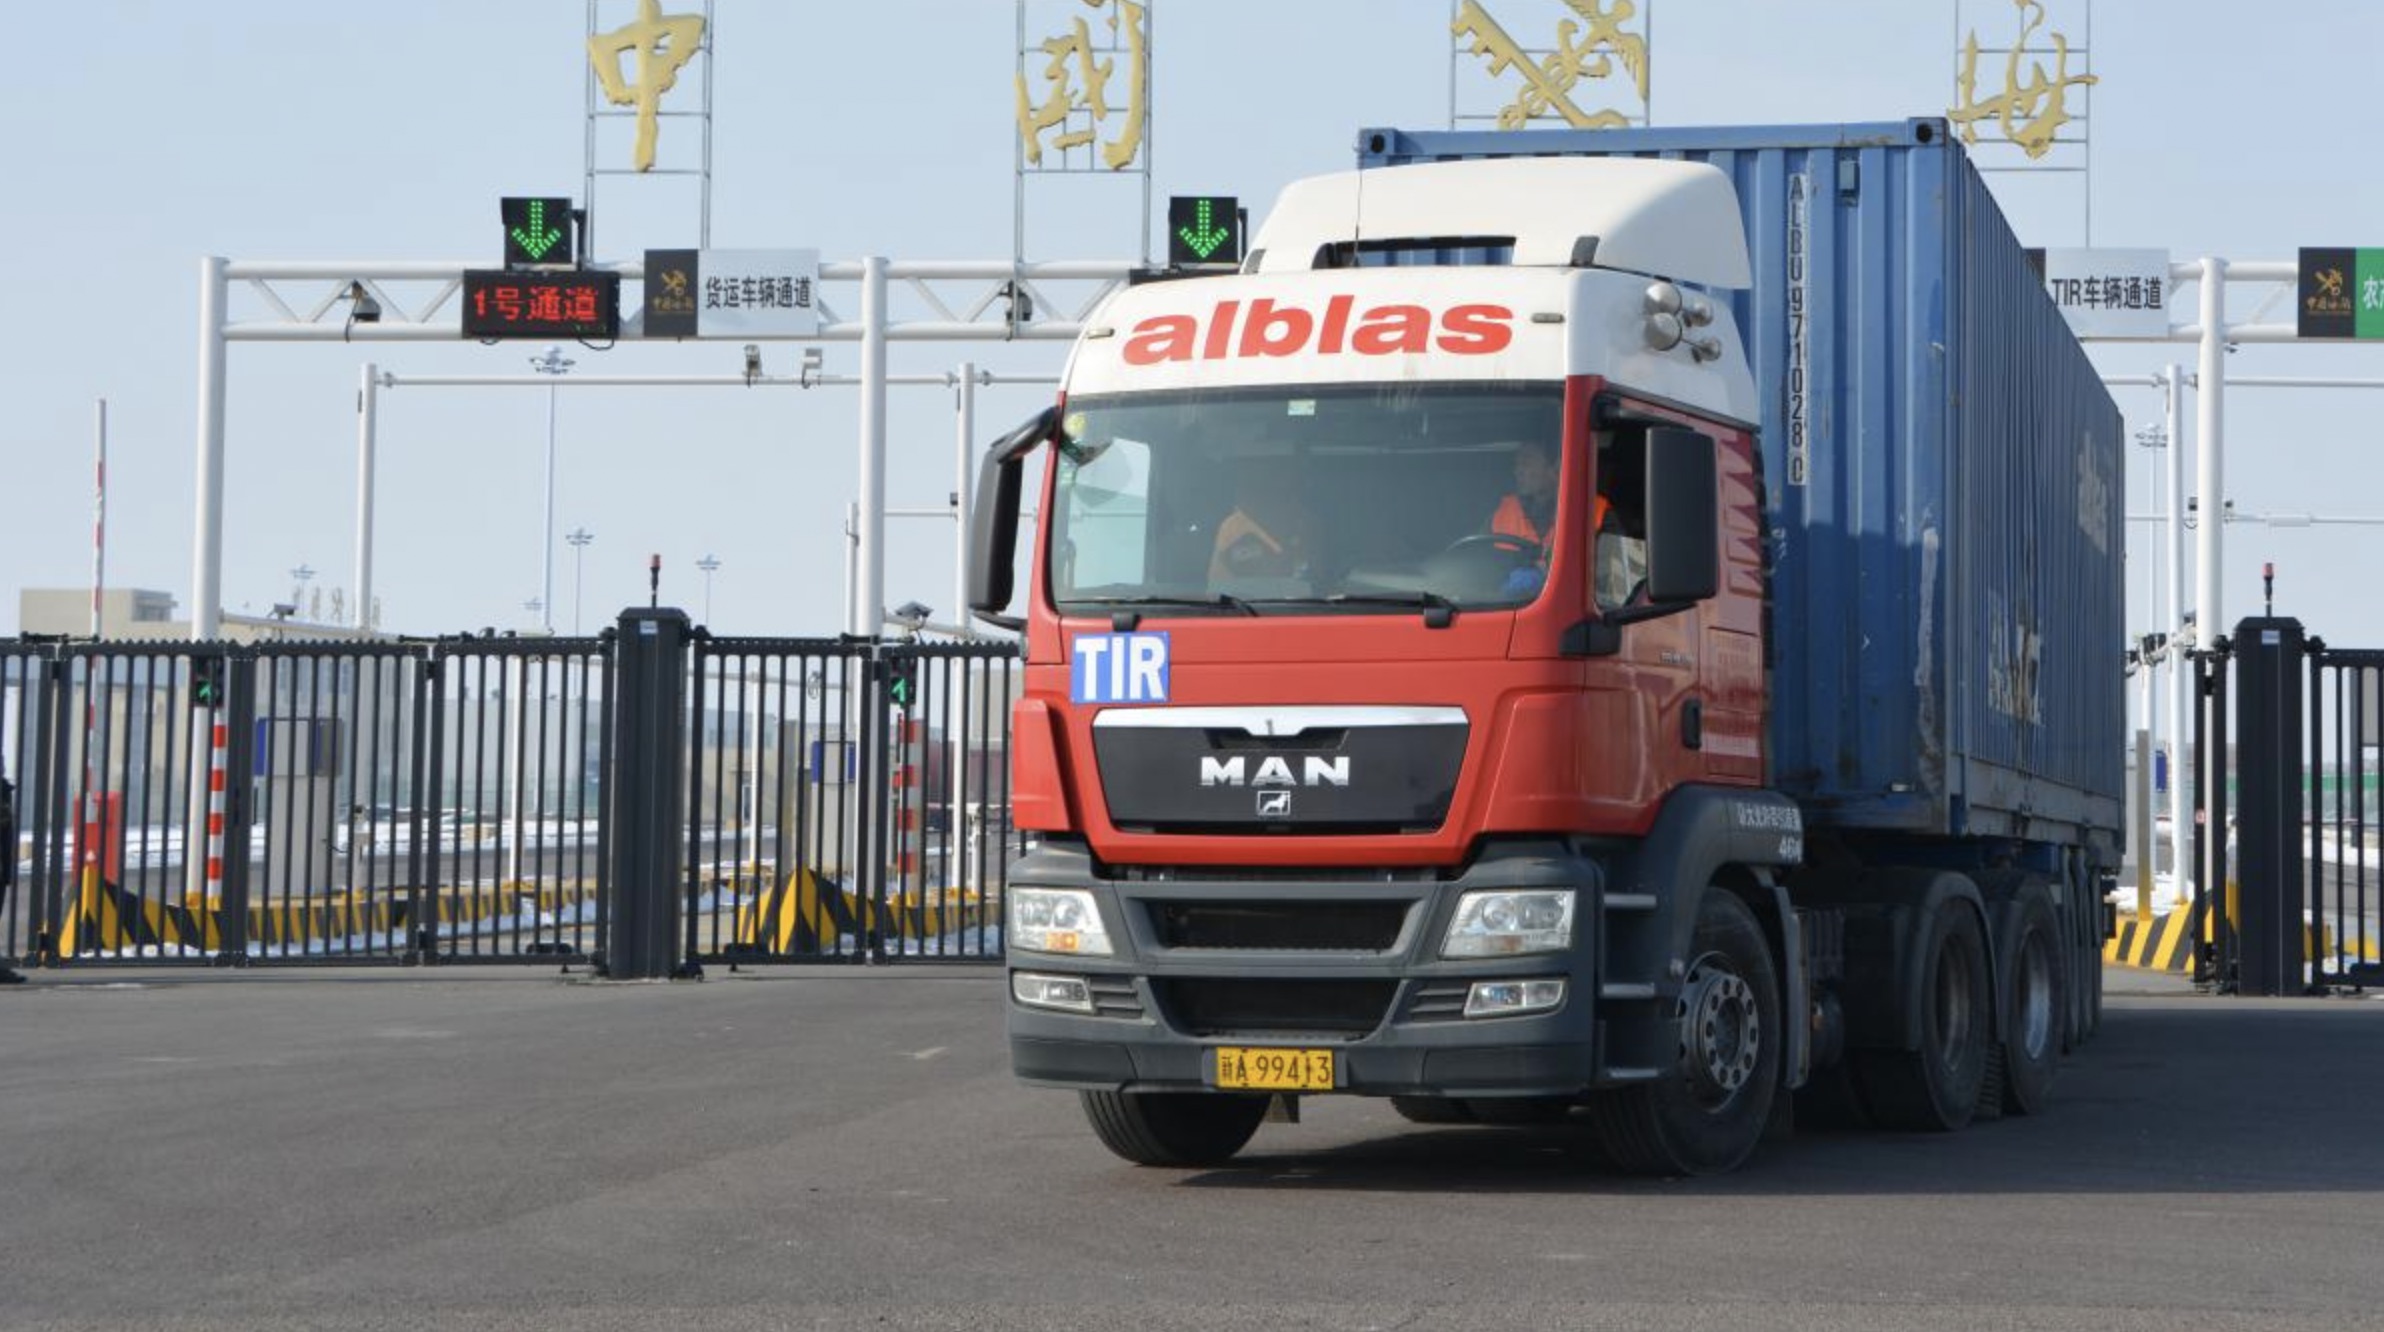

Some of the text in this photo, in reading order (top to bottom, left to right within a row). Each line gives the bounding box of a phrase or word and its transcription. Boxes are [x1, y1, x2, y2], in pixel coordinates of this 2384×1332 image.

[474, 285, 599, 321] 1号通道
[705, 275, 812, 309] 货运车辆通道
[2051, 275, 2163, 310] TIR车辆通道
[2363, 274, 2384, 311] 农
[1122, 295, 1513, 365] alblas
[1790, 286, 1803, 447] 971028
[1076, 637, 1165, 700] TIR
[1201, 756, 1350, 786] MAN
